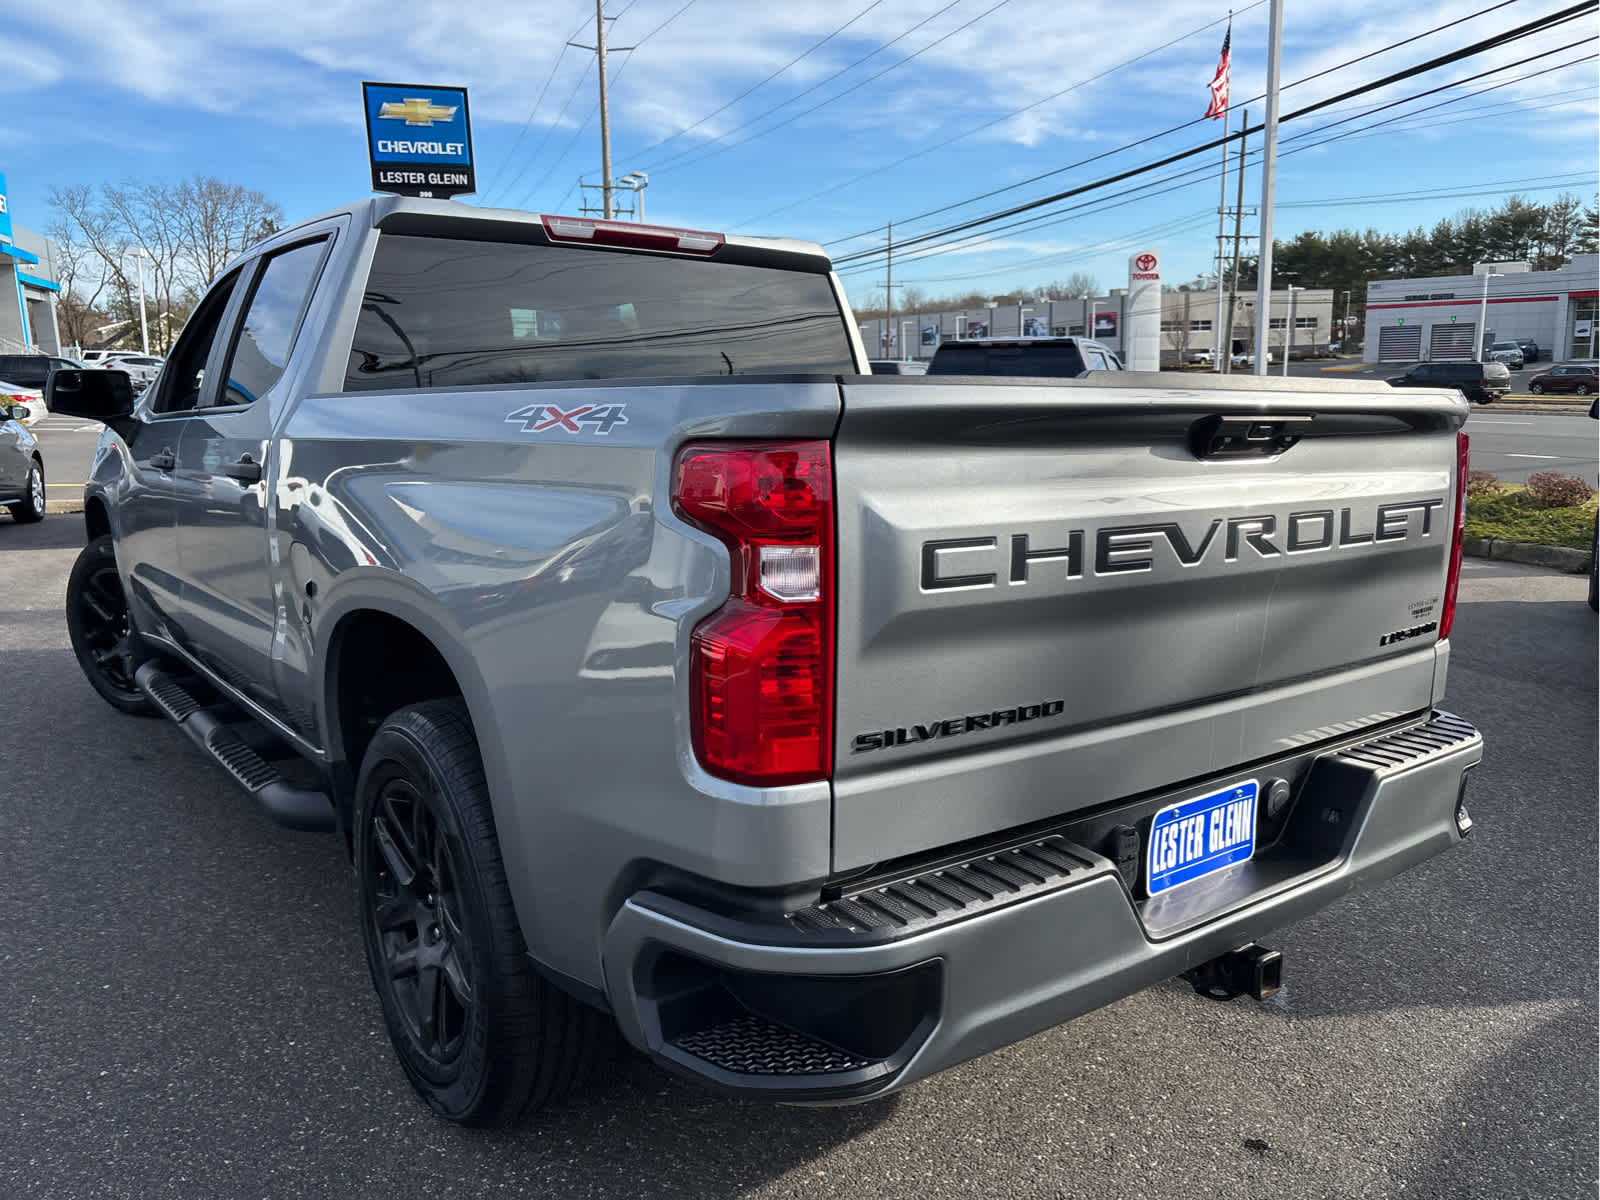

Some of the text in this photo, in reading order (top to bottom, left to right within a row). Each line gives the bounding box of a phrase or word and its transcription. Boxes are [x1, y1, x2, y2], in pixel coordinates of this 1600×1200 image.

[377, 140, 465, 156] CHEVROLET
[380, 171, 468, 185] LESTER GLENN
[1132, 272, 1160, 280] TOYOTA
[919, 497, 1444, 594] CHEVROLET
[851, 699, 1065, 755] SILVERADO
[1152, 797, 1253, 875] LESTER GLENN
